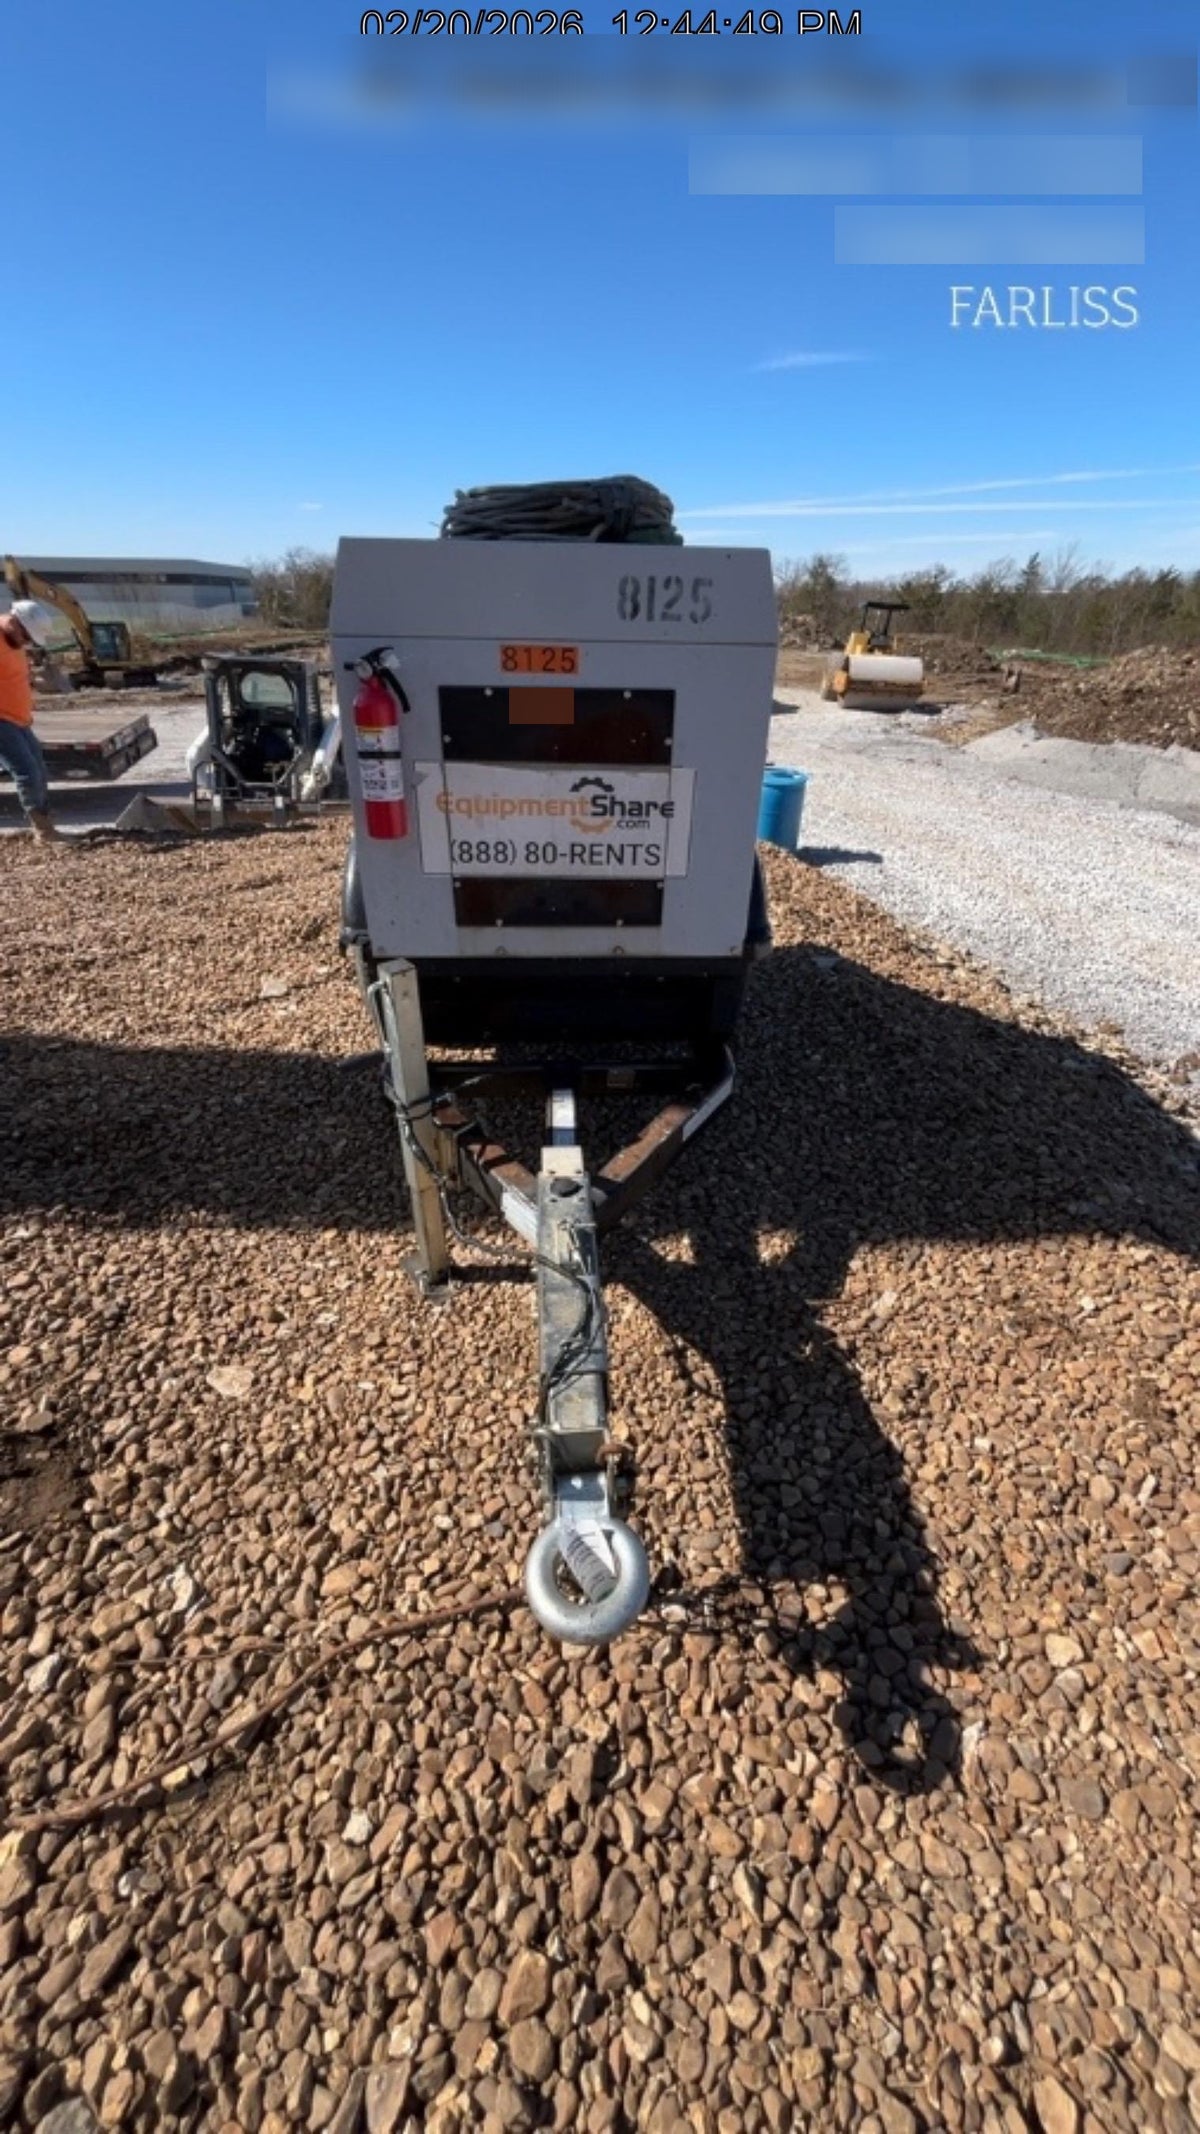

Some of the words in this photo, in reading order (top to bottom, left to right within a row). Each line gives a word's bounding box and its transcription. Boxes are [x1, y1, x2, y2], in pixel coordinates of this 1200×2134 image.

[618, 575, 713, 623] 8125
[501, 646, 576, 673] 8125
[435, 793, 675, 820] EquipmentShare
[449, 840, 517, 867] (888)
[524, 842, 661, 866] 80-RENTS
